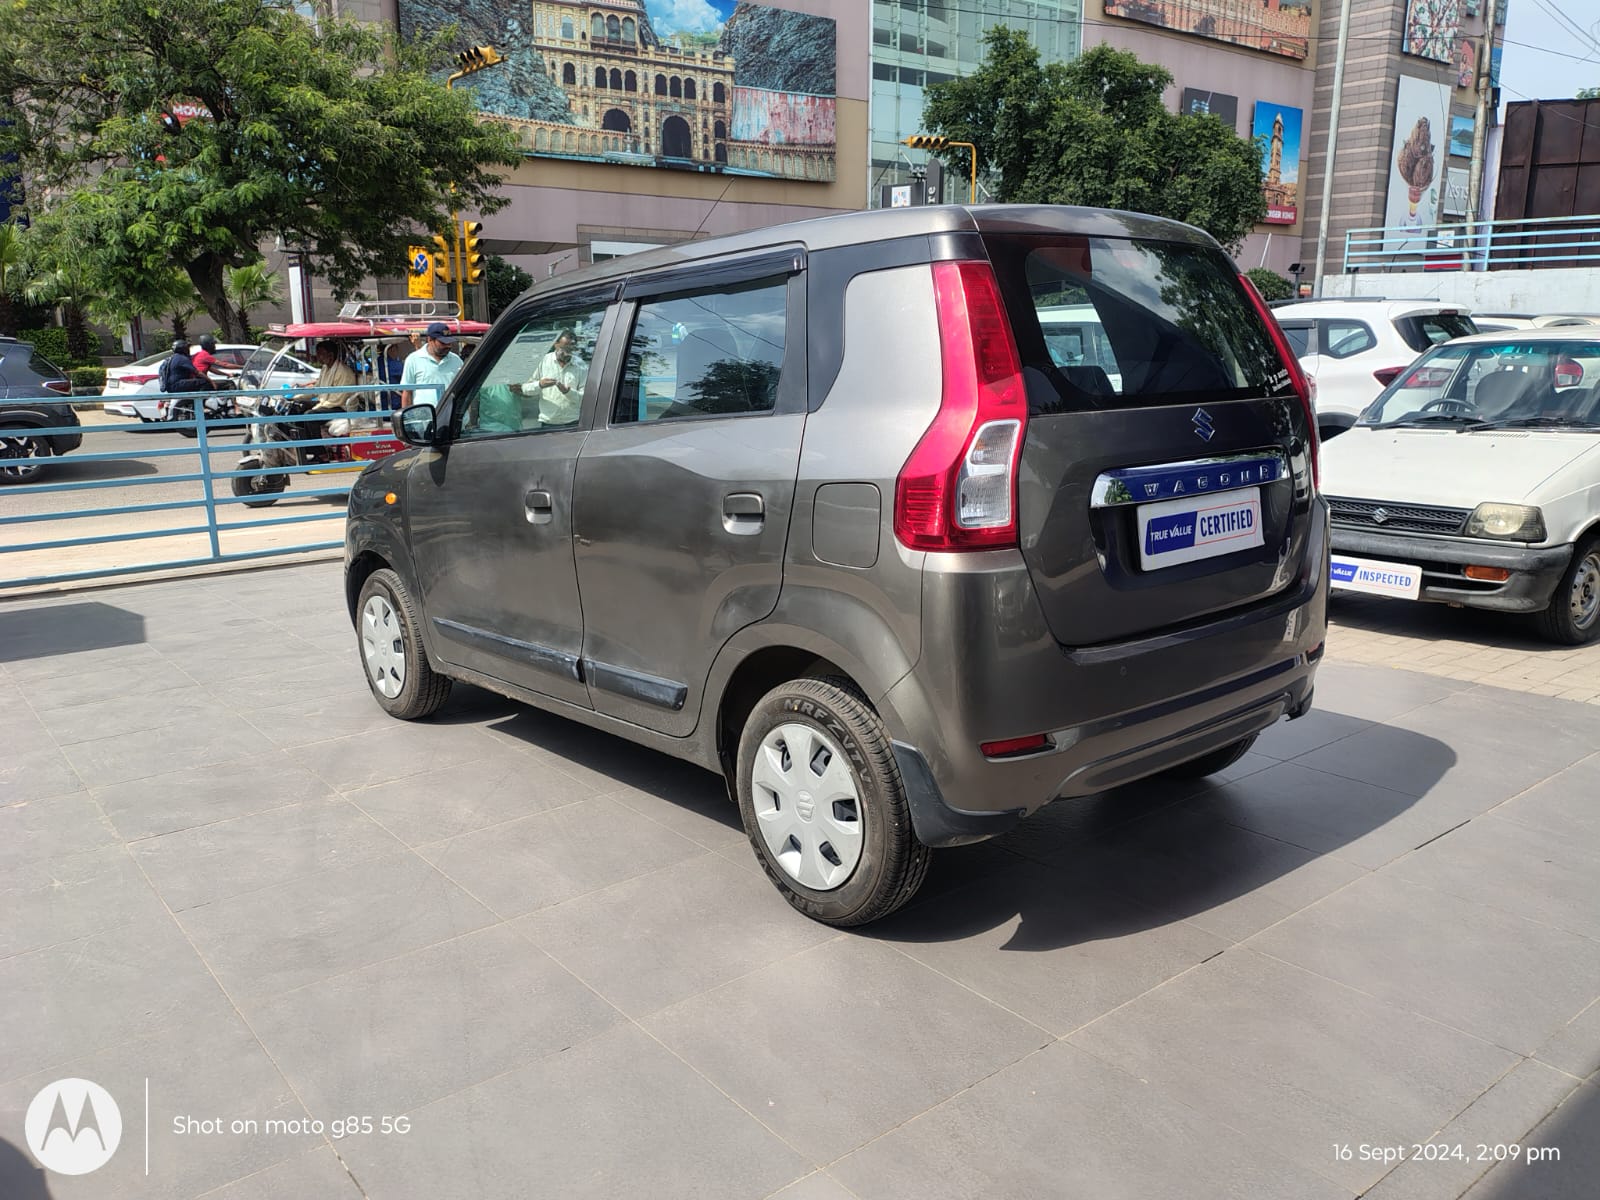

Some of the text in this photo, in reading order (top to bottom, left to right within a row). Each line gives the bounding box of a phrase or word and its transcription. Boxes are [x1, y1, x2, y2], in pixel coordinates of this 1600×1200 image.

[1150, 508, 1253, 542] TRUE VALUE CERTIFIED
[1359, 569, 1412, 587] INSPECTED
[783, 699, 828, 720] MRF
